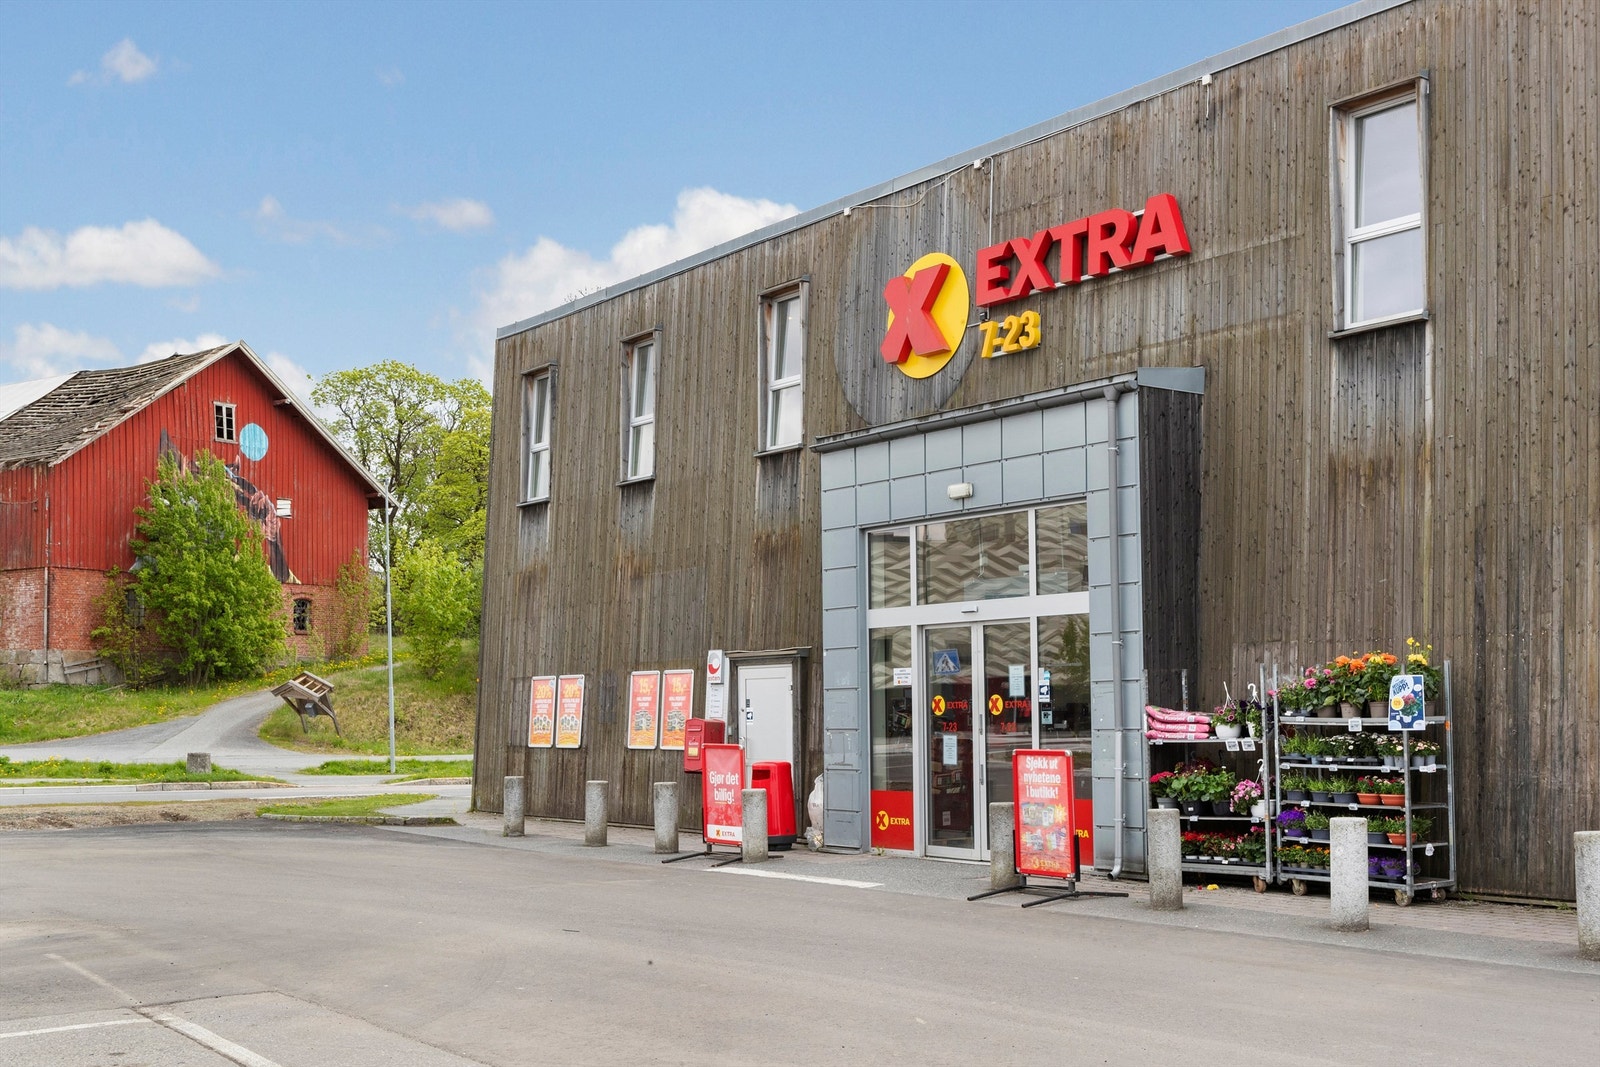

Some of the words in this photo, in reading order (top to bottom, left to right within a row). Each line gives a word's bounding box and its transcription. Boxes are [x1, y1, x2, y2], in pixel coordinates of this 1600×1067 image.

[881, 263, 951, 364] X
[976, 193, 1191, 308] EXTRA
[979, 310, 1041, 359] 7-23
[947, 701, 969, 709] EXTRA
[1005, 700, 1028, 709] EXTRA
[942, 722, 958, 732] 7-23
[1026, 756, 1048, 771] Sjekk
[1049, 758, 1058, 769] ut
[709, 771, 725, 787] Gjør
[725, 772, 739, 785] det
[1023, 771, 1062, 785] nyhetene
[714, 787, 735, 805] billig!
[1030, 786, 1059, 800] butikk!
[890, 817, 910, 826] EXTRA
